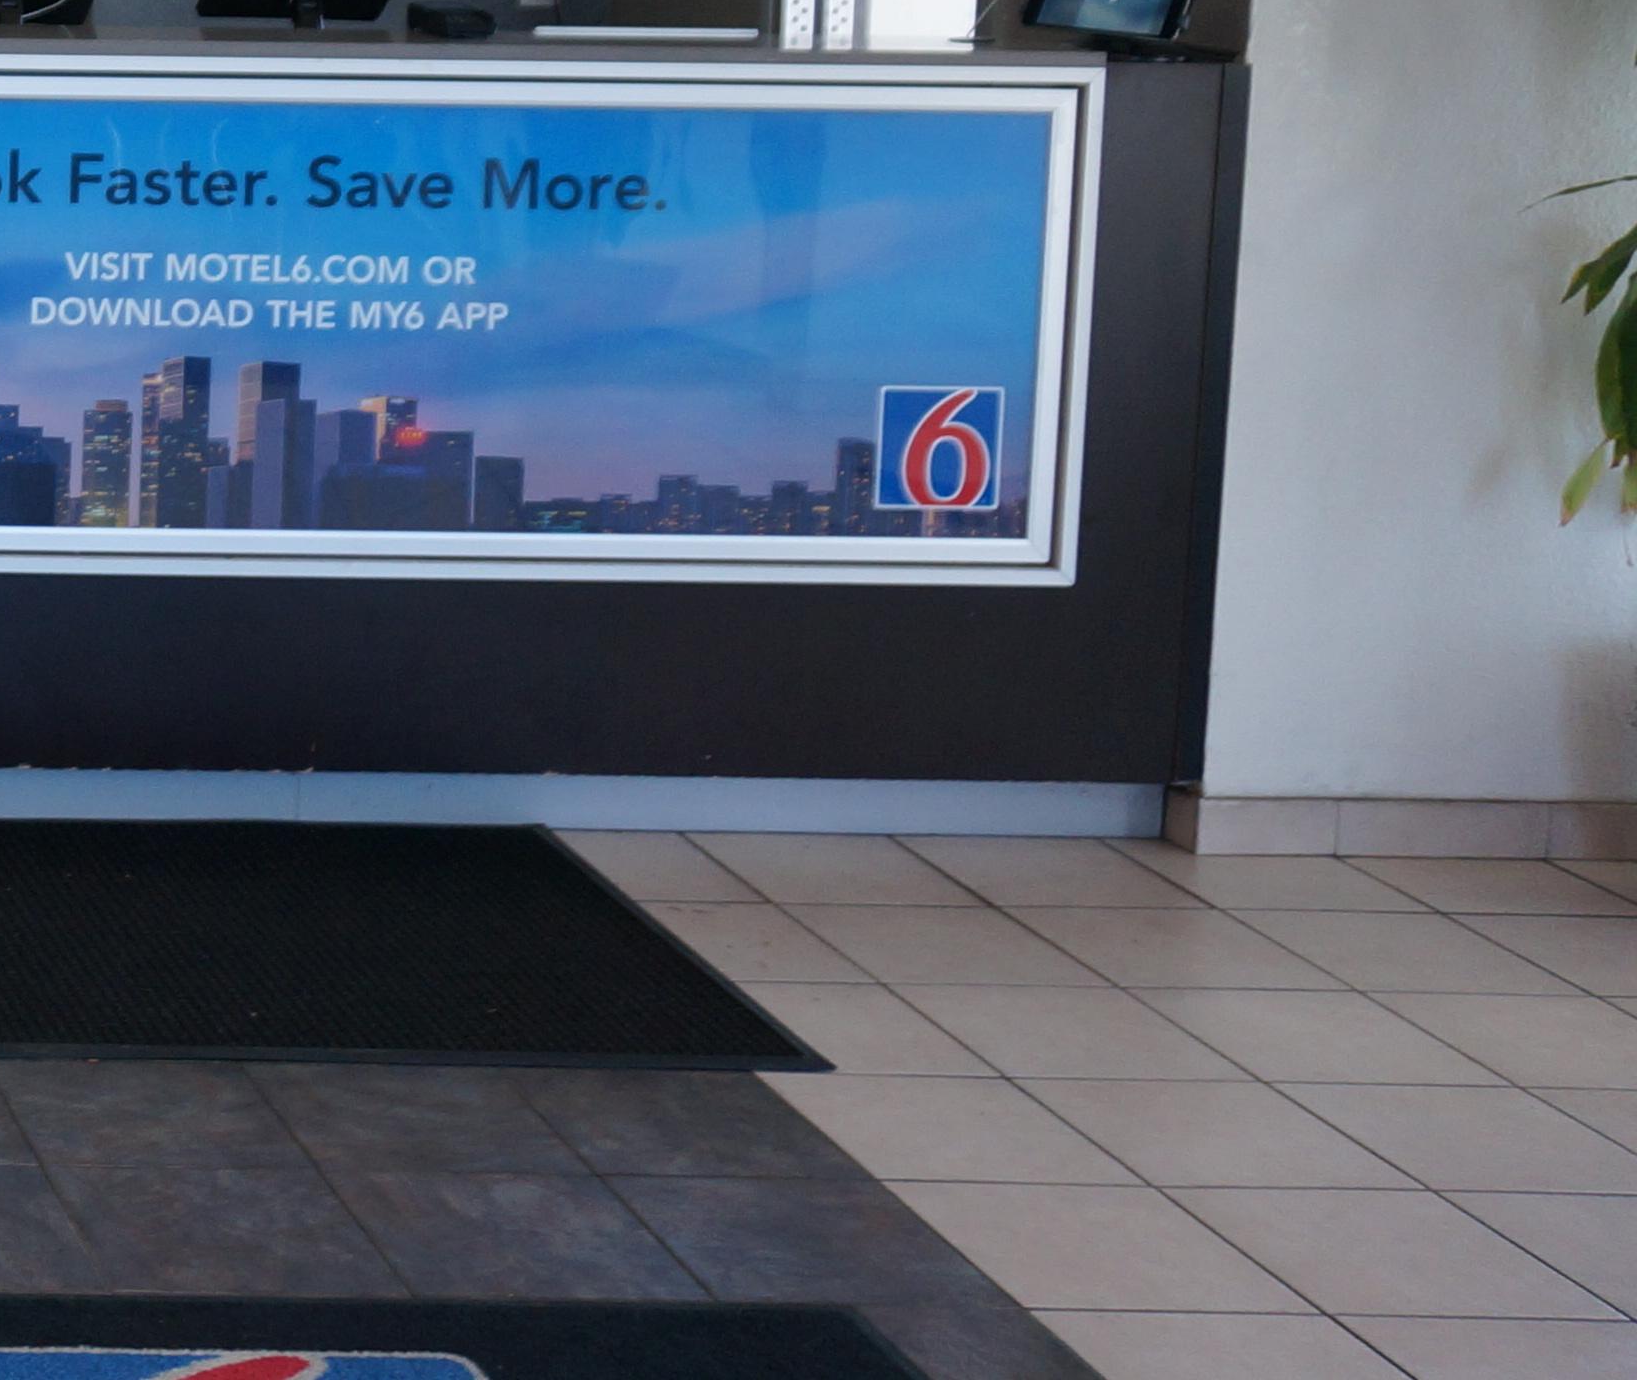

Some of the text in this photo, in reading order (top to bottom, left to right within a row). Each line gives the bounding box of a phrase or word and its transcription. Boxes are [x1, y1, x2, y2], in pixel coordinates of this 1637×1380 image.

[69, 152, 277, 208] Faster.
[306, 155, 454, 210] Save
[482, 157, 668, 212] More.
[65, 251, 477, 286] VISIT MOTEL6.COM OR
[29, 297, 509, 331] DOWNLOAD THE MY6 APP
[901, 387, 990, 508] 6
